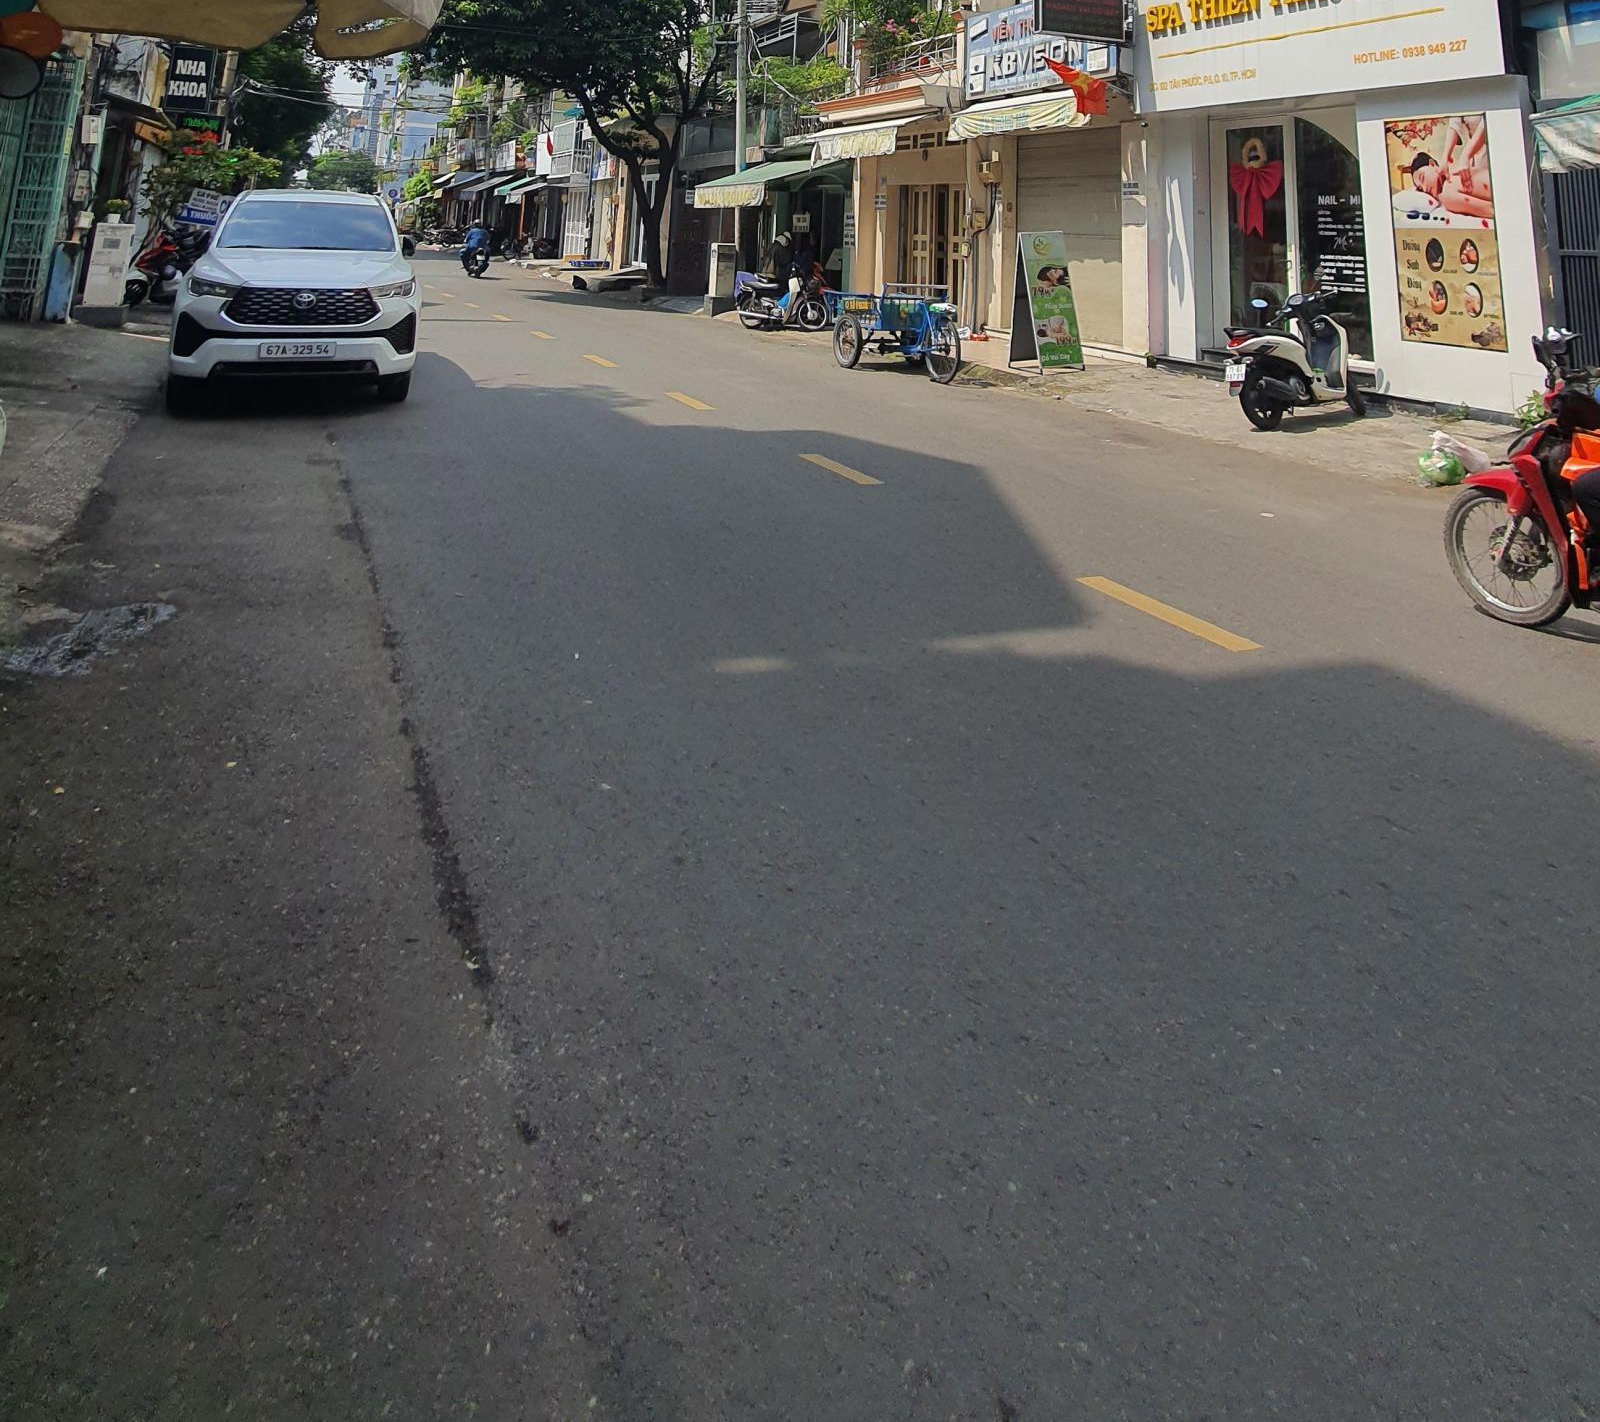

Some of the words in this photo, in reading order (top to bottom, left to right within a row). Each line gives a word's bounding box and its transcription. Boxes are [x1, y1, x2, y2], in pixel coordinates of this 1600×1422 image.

[1145, 2, 1184, 32] SPA
[1354, 49, 1400, 64] HOTLINE:
[1402, 45, 1425, 59] 0938
[1428, 42, 1446, 55] 949
[1449, 39, 1467, 52] 227
[175, 59, 206, 77] NHA
[168, 80, 207, 98] KHOA
[1318, 195, 1338, 205] NAIL
